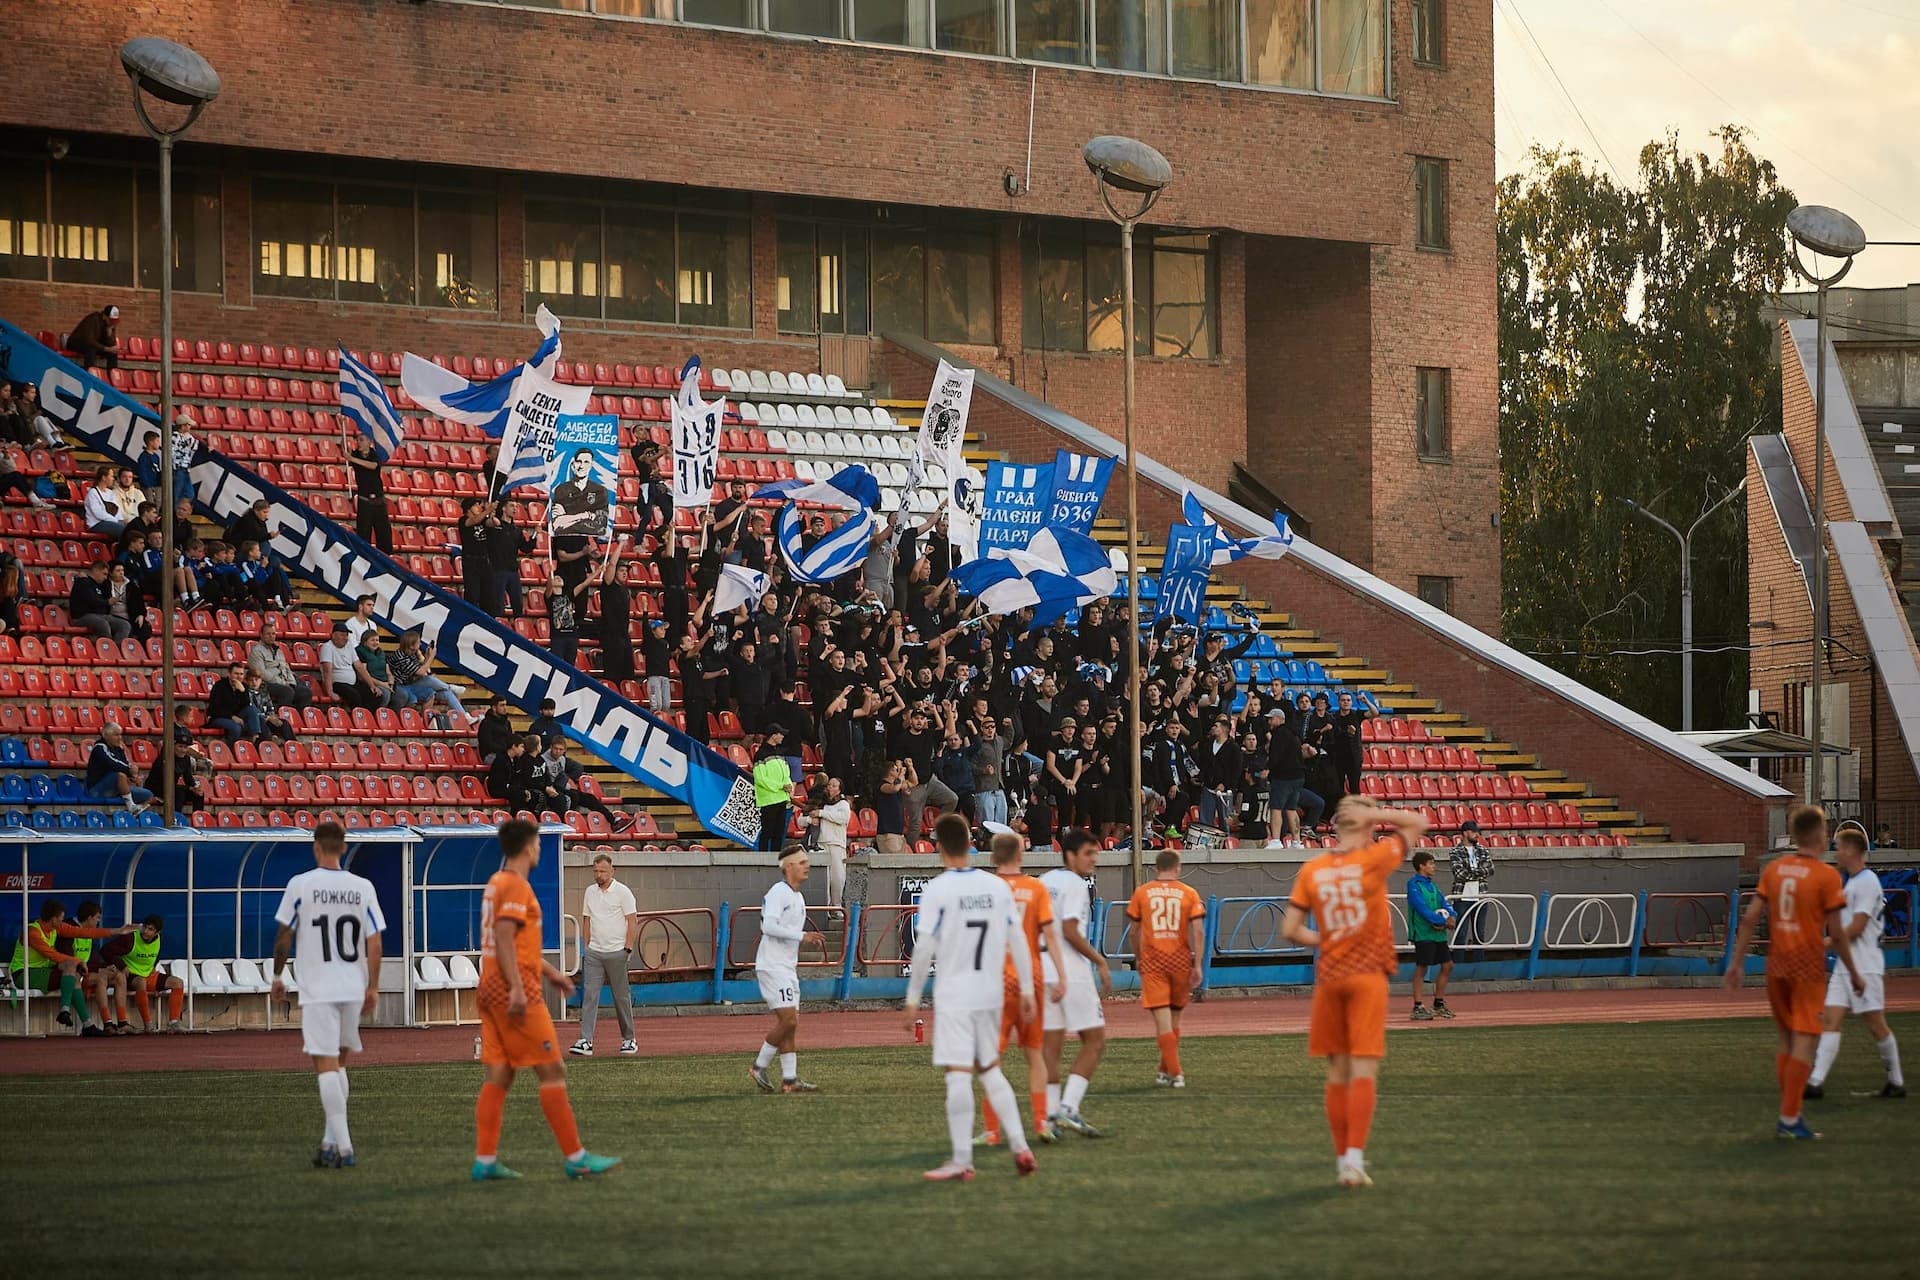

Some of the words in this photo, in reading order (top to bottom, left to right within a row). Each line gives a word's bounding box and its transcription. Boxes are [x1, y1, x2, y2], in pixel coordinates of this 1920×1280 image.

[531, 392, 562, 412] СЕКТА
[564, 421, 613, 435] АЛЕКСЕЙ
[557, 431, 618, 446] МЕДВЕДЕВ
[995, 490, 1035, 507] ГРАД
[1056, 488, 1099, 503] СИБИРЬ
[981, 507, 1042, 524] ИМЕНИ
[1051, 503, 1092, 525] 1936
[986, 527, 1029, 544] ЦАРЯ
[456, 622, 688, 787] СТИЛЬ
[313, 889, 361, 905] РОЖКОВ
[959, 894, 994, 911] КОНЕВ
[1318, 880, 1368, 931] 25
[1779, 878, 1796, 920] 6
[1150, 896, 1181, 932] 20
[312, 914, 361, 963] 10
[966, 920, 989, 971] 7
[779, 988, 793, 1002] 19
